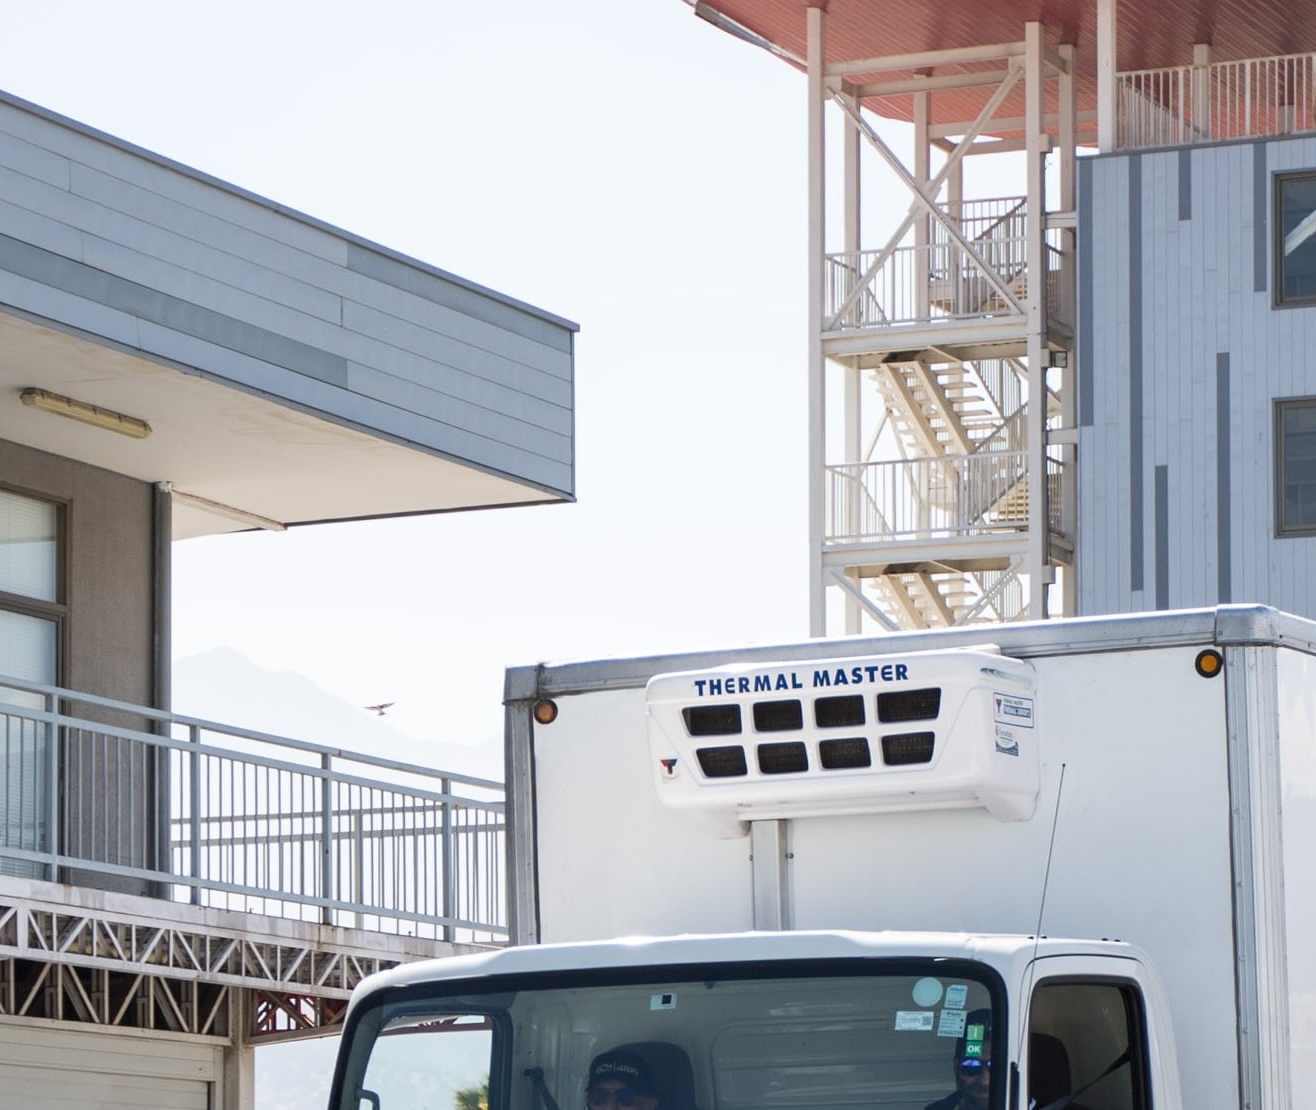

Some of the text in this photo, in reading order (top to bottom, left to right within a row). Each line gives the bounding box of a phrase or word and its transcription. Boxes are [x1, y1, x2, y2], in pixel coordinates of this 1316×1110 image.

[694, 664, 909, 697] THERMAL MASTER
[966, 1044, 982, 1053] OK
